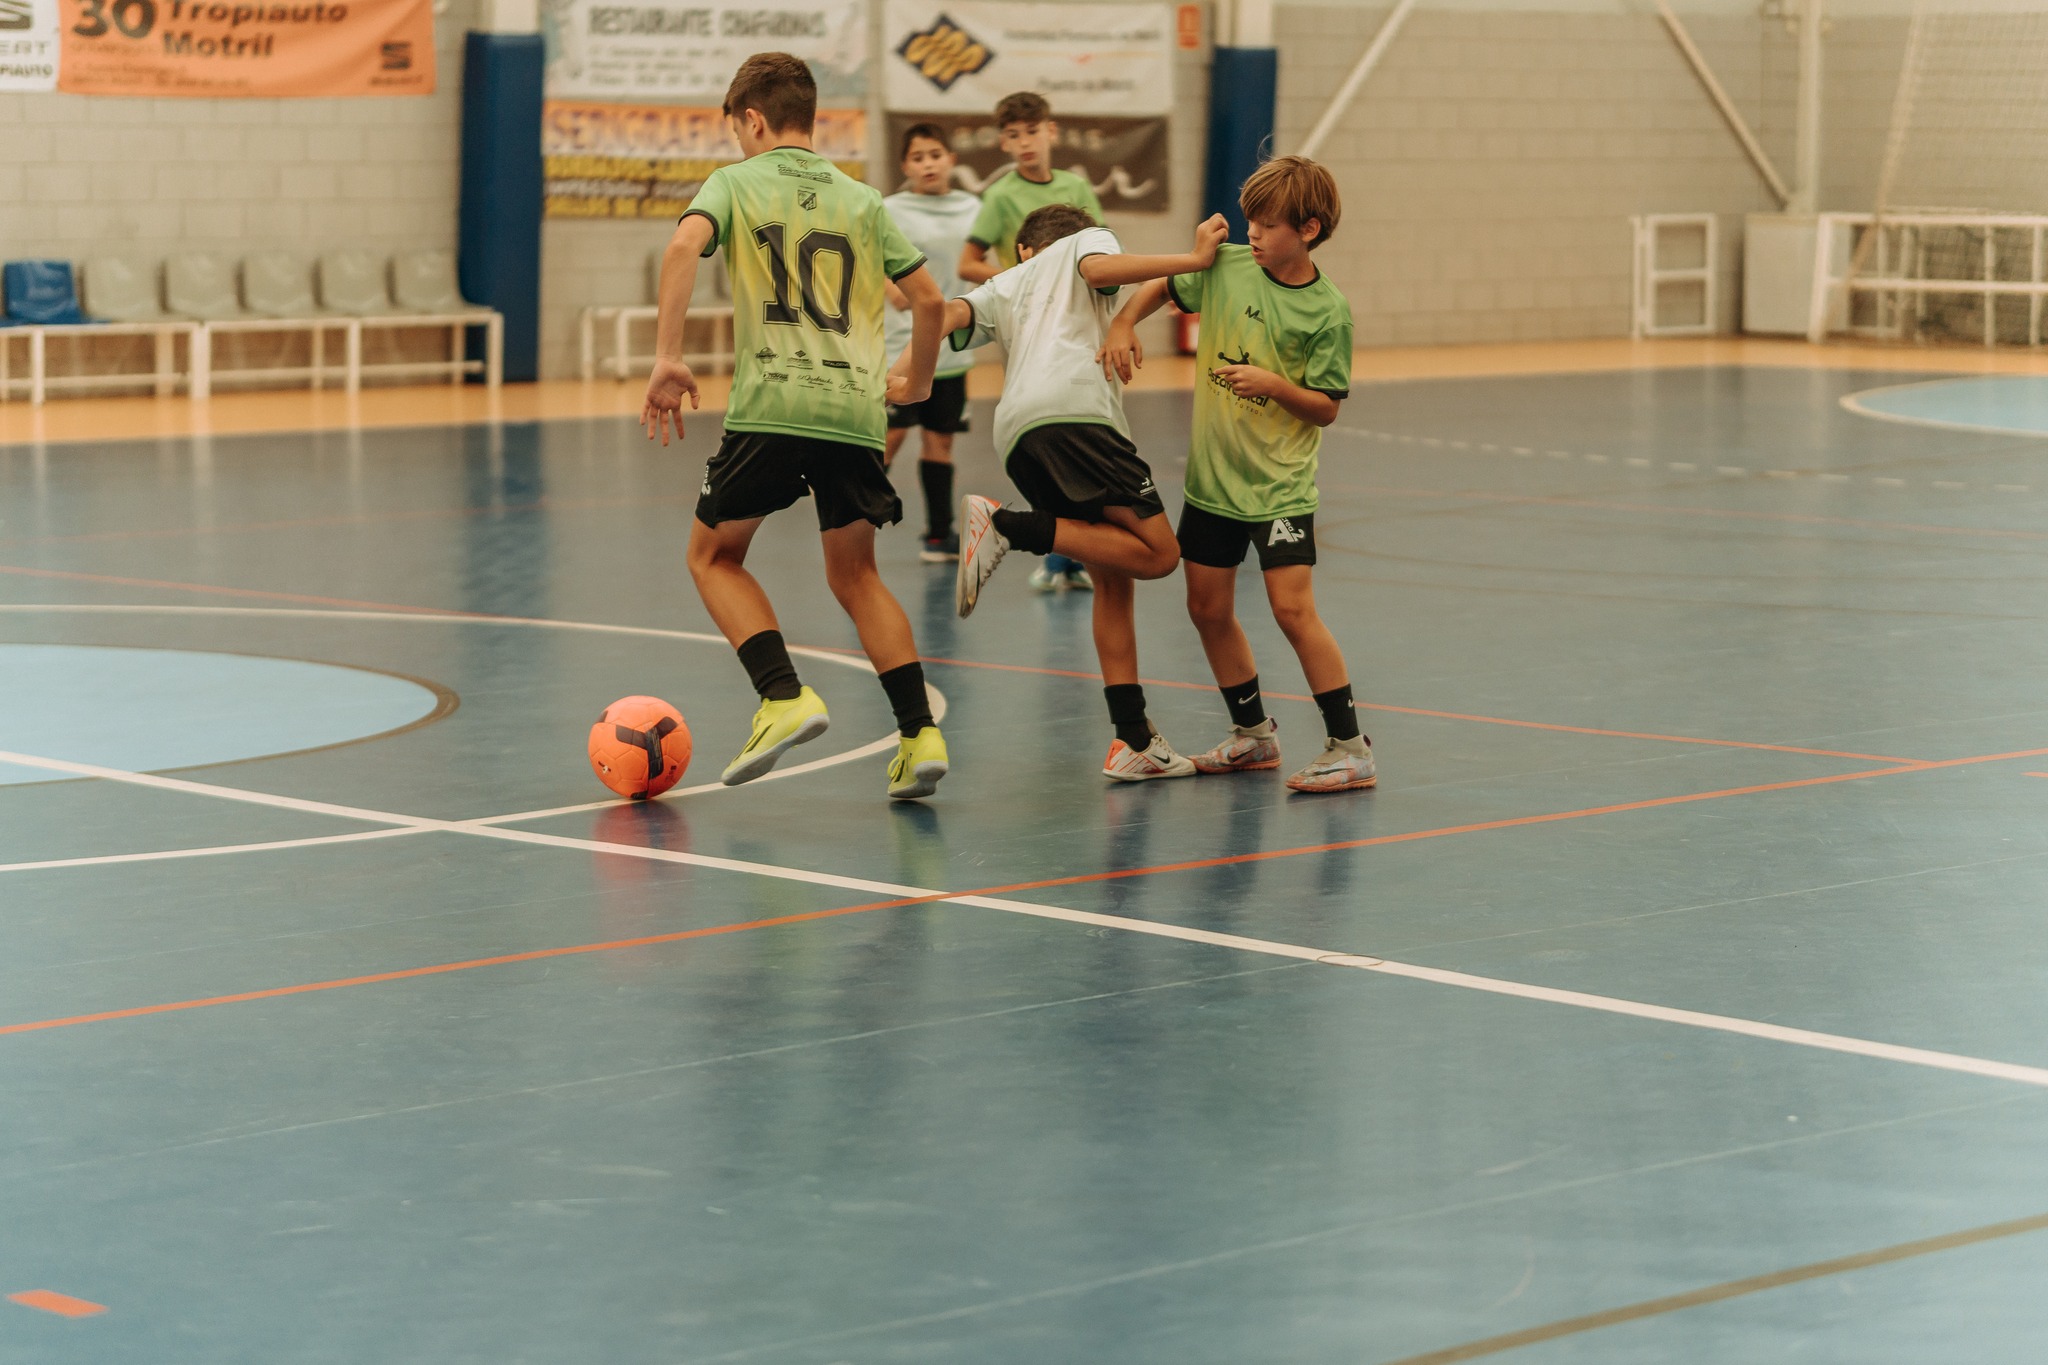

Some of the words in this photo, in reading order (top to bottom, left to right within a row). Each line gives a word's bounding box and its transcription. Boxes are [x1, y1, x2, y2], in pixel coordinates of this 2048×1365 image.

[74, 0, 156, 38] 30
[168, 0, 348, 27] Tropiauto
[163, 31, 273, 56] Motril
[752, 221, 857, 338] 10
